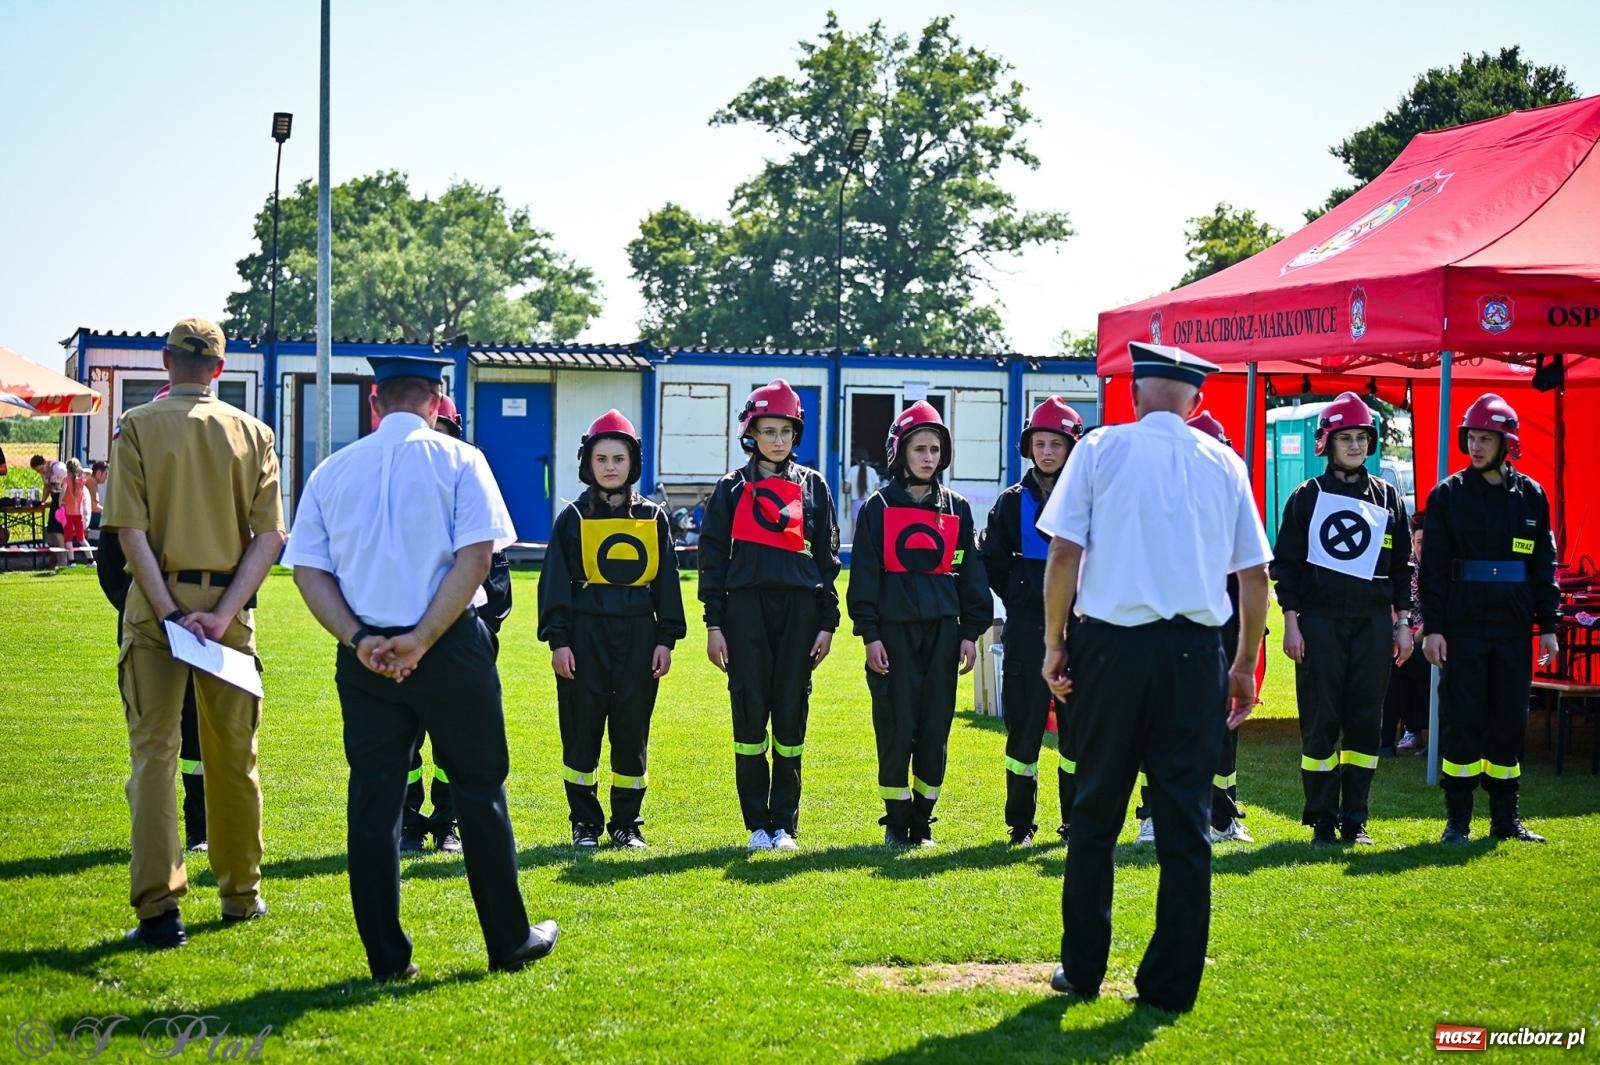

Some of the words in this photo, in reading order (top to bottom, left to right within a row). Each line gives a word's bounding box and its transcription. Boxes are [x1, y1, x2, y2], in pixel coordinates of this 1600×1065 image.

[1173, 320, 1193, 344] OSP
[1196, 306, 1337, 343] RACIBÓRZ-MARKOWICE
[1548, 305, 1600, 327] OSP
